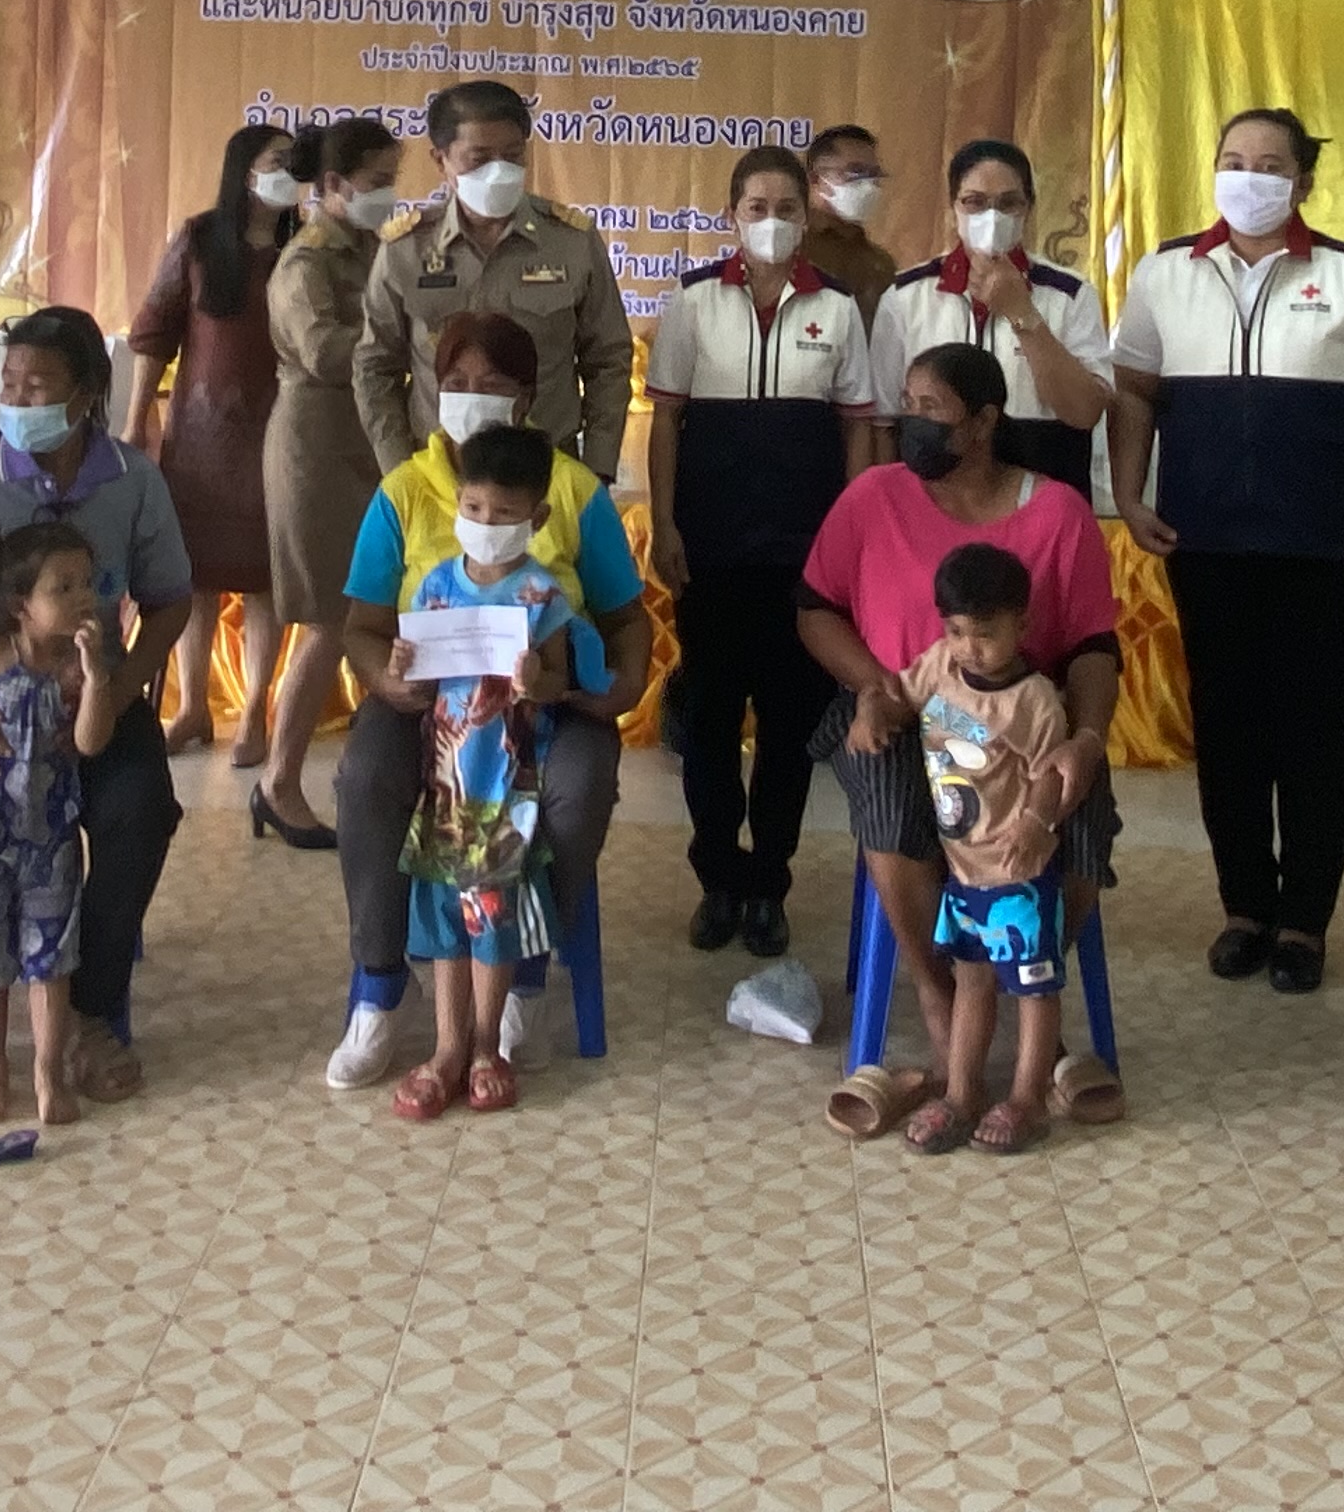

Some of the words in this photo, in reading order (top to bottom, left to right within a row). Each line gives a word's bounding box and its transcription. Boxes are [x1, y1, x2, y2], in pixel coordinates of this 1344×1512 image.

[360, 43, 571, 75] ประจำปีงบประมาณ
